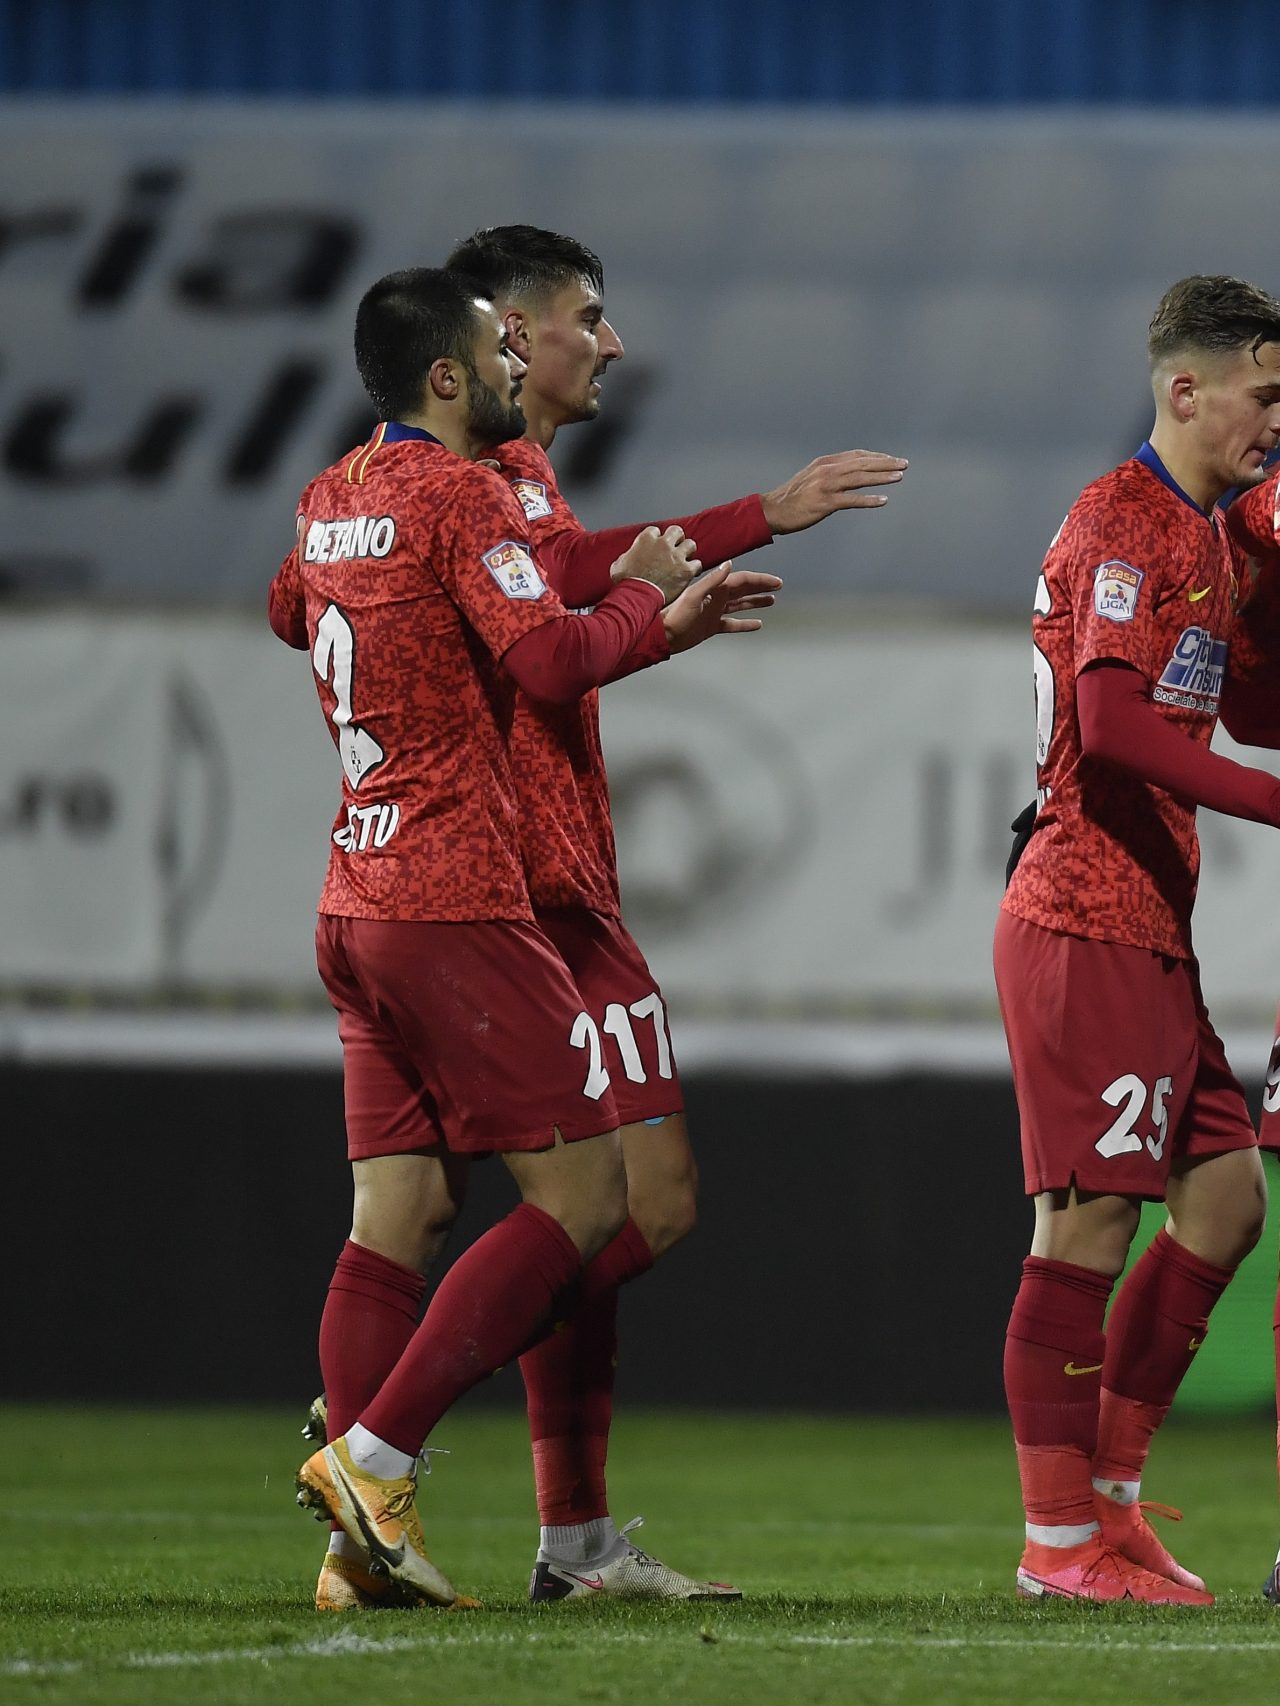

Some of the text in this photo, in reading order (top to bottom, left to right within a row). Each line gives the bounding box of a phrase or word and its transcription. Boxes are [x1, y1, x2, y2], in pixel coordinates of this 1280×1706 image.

[304, 515, 396, 564] BETANO
[312, 603, 385, 791] 2
[568, 1010, 611, 1101] 2
[602, 991, 673, 1085] 17
[1094, 1073, 1173, 1162] 25
